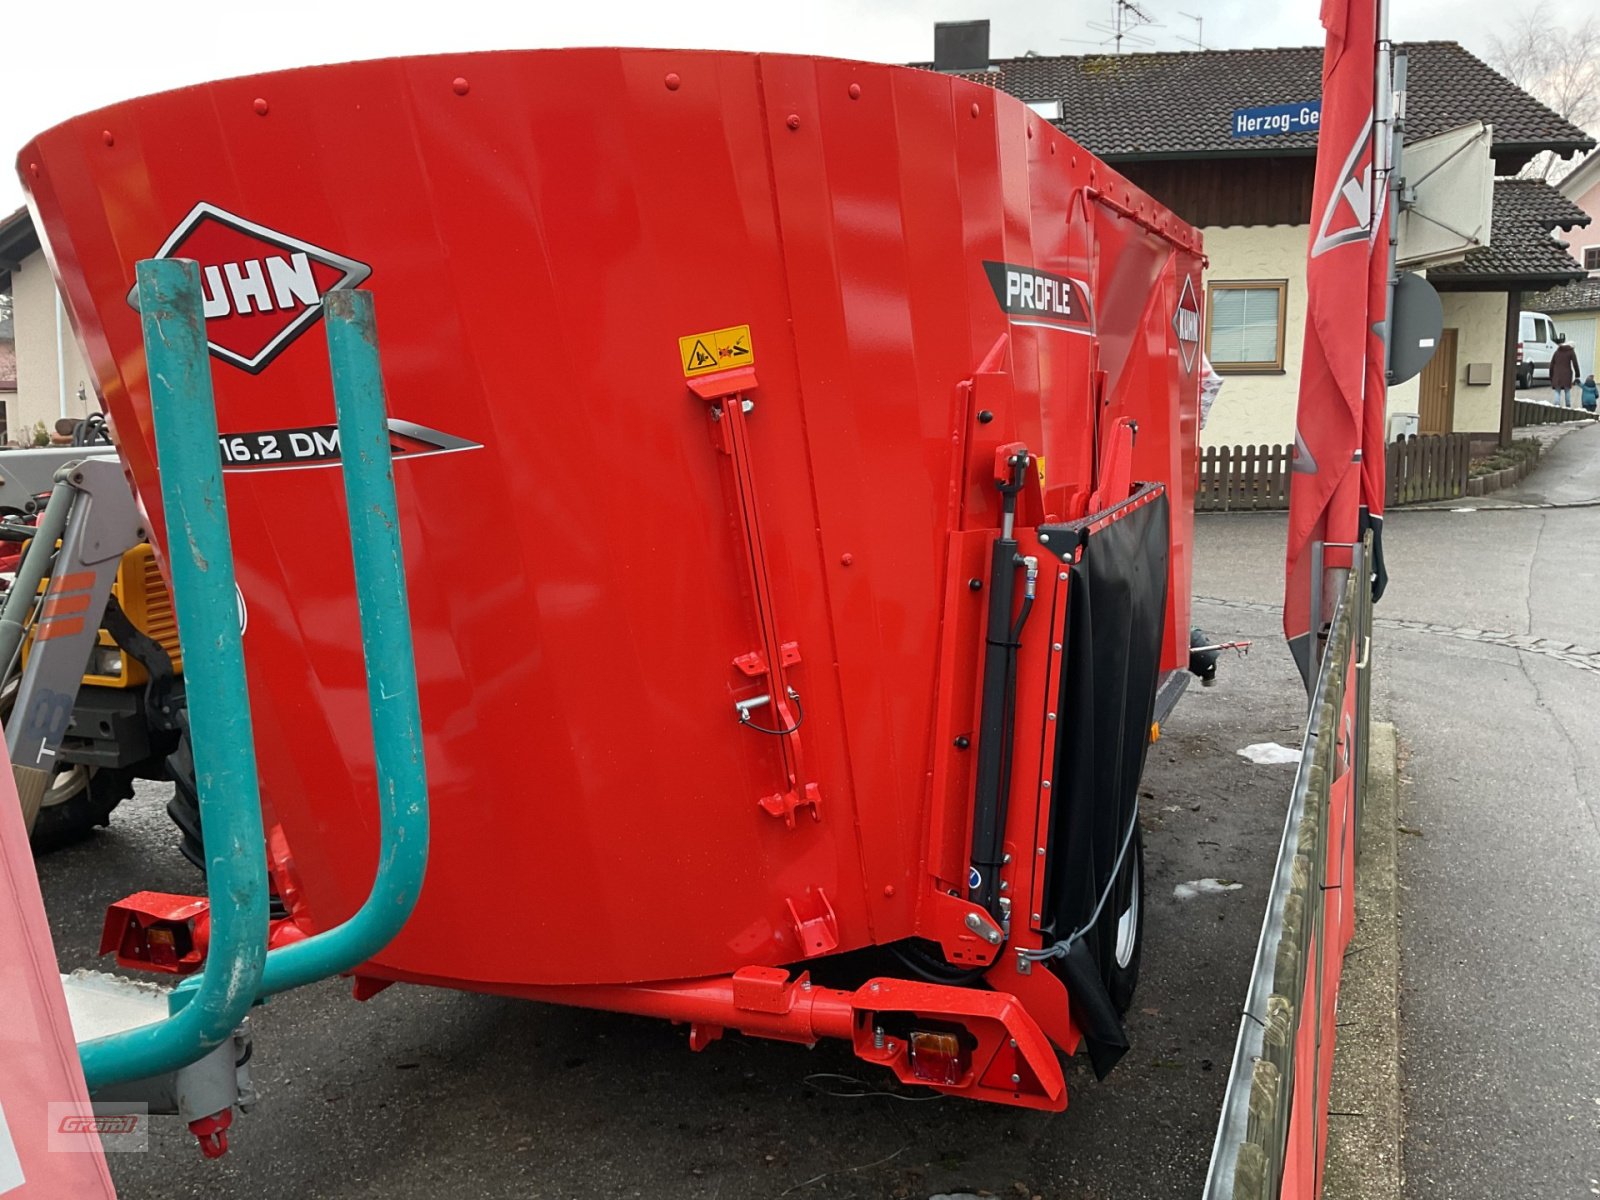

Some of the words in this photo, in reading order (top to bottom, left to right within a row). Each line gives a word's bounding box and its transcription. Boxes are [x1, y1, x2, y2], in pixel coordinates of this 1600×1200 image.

[1237, 107, 1320, 133] Herzog-Ge
[201, 252, 320, 318] UHN
[1006, 270, 1071, 315] PROFILE
[219, 435, 282, 461] 16.2
